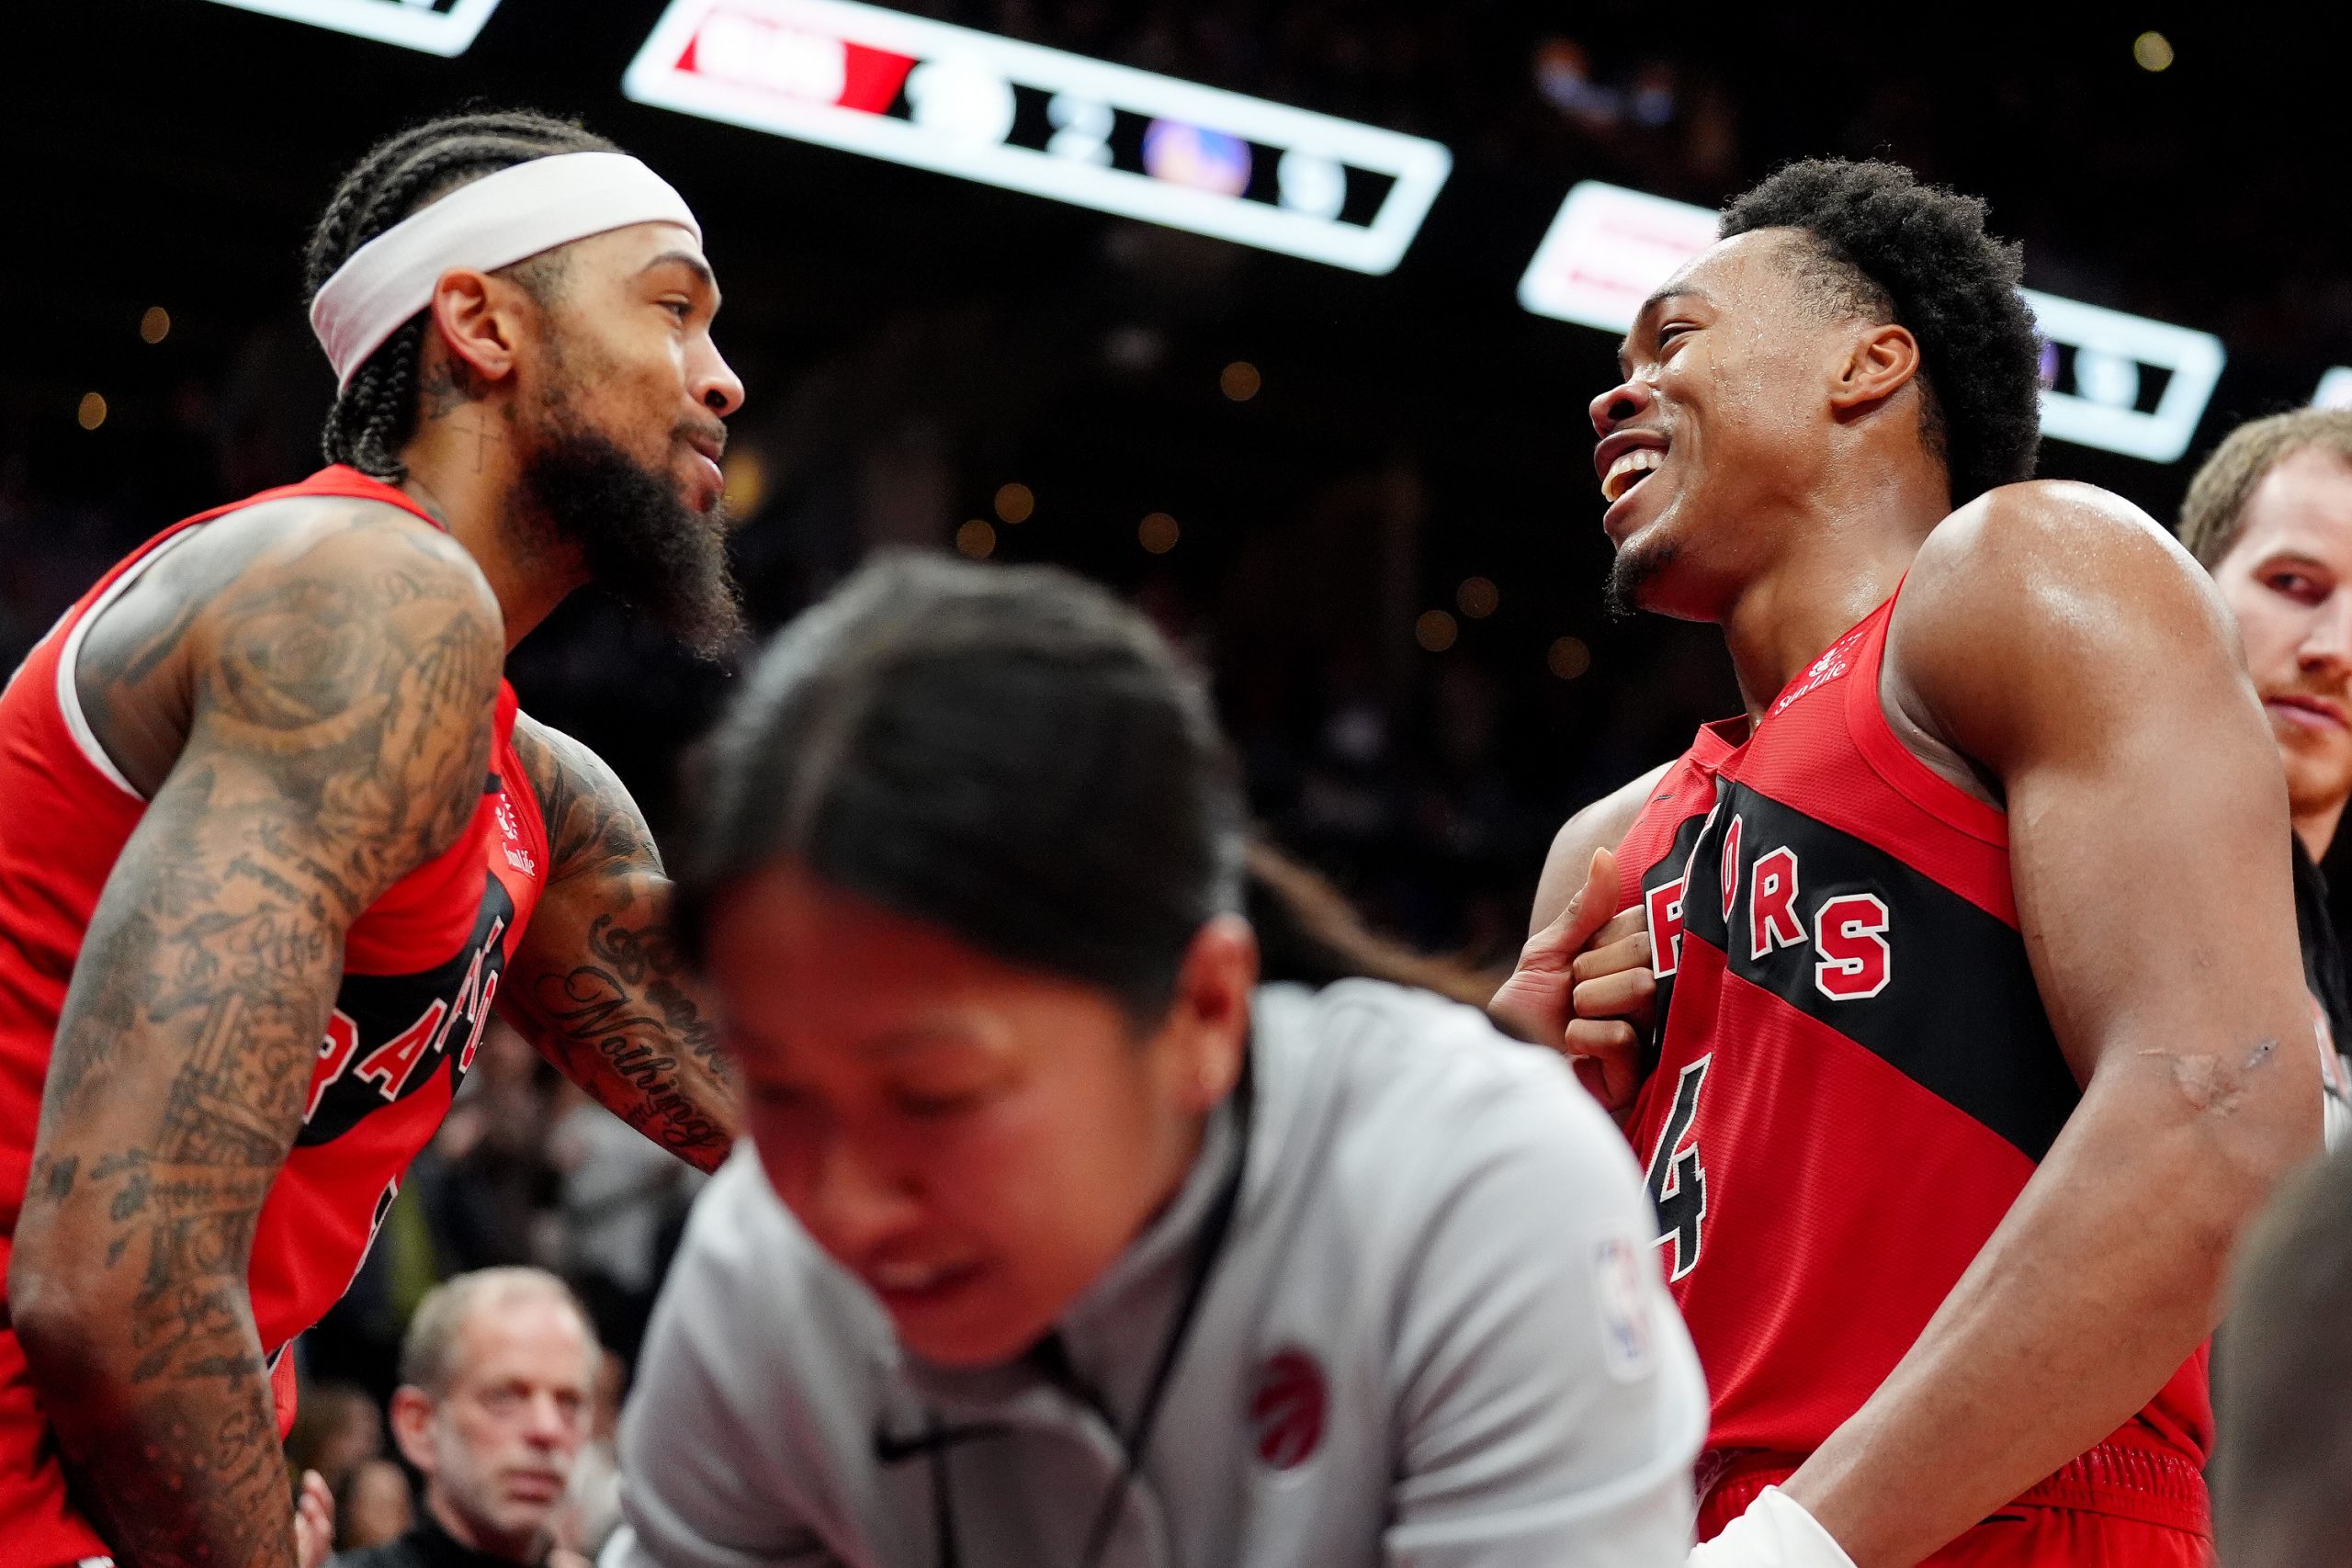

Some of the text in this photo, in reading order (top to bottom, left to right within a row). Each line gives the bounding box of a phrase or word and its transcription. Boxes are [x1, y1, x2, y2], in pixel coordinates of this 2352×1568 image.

[1774, 663, 1846, 716] Sun Life
[1643, 1052, 1713, 1283] 4
